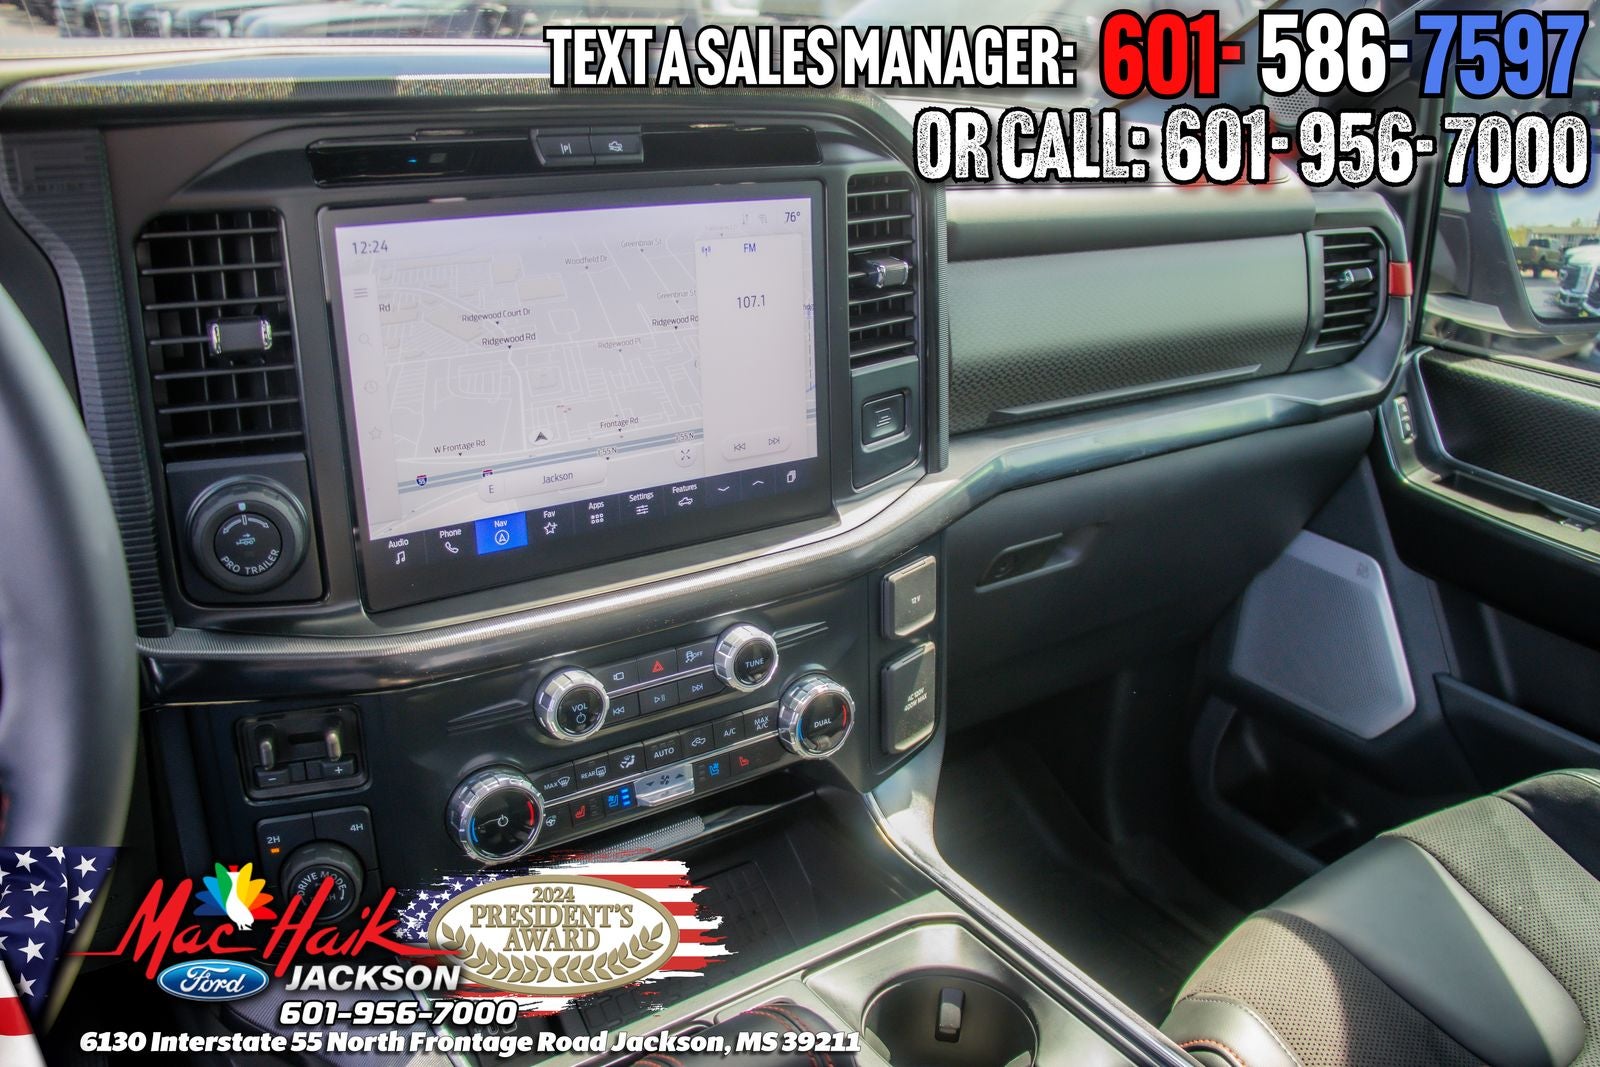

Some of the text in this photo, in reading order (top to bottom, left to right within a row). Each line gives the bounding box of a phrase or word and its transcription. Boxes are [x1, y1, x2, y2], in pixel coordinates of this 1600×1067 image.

[352, 239, 389, 255] 12:24
[743, 242, 757, 253] FM
[565, 255, 599, 266] Woodfield
[378, 303, 391, 312] Rd
[736, 294, 766, 310] 107.1
[461, 307, 531, 322] Ridgewood Court Dr
[652, 315, 687, 327] Ridgewood
[482, 332, 536, 347] Ridgewood Rd
[598, 339, 633, 350] Ridgewood
[600, 416, 639, 430] Frontage Rd
[433, 438, 486, 454] W Frontage Rd
[542, 471, 573, 484] Jackson
[488, 484, 494, 494] E
[672, 483, 698, 494] Features
[628, 491, 654, 503] Settings
[588, 501, 605, 511] Apps
[543, 510, 556, 519] Fav
[494, 520, 508, 528] Nav
[439, 527, 462, 539] Phone
[388, 538, 409, 549] Audio
[220, 548, 280, 575] PRO TRAILER
[744, 657, 765, 669] TUNE
[571, 703, 588, 714] VOL
[754, 715, 769, 726] MAX
[813, 717, 832, 729] DUAL
[723, 727, 737, 738] A/C
[756, 722, 769, 732] A/C
[653, 746, 675, 759] AUTO
[580, 770, 596, 780] REAR
[543, 781, 558, 791] MAX
[350, 823, 364, 832] 4H
[266, 835, 280, 844] 2H
[296, 870, 347, 897] DRIVE MODE
